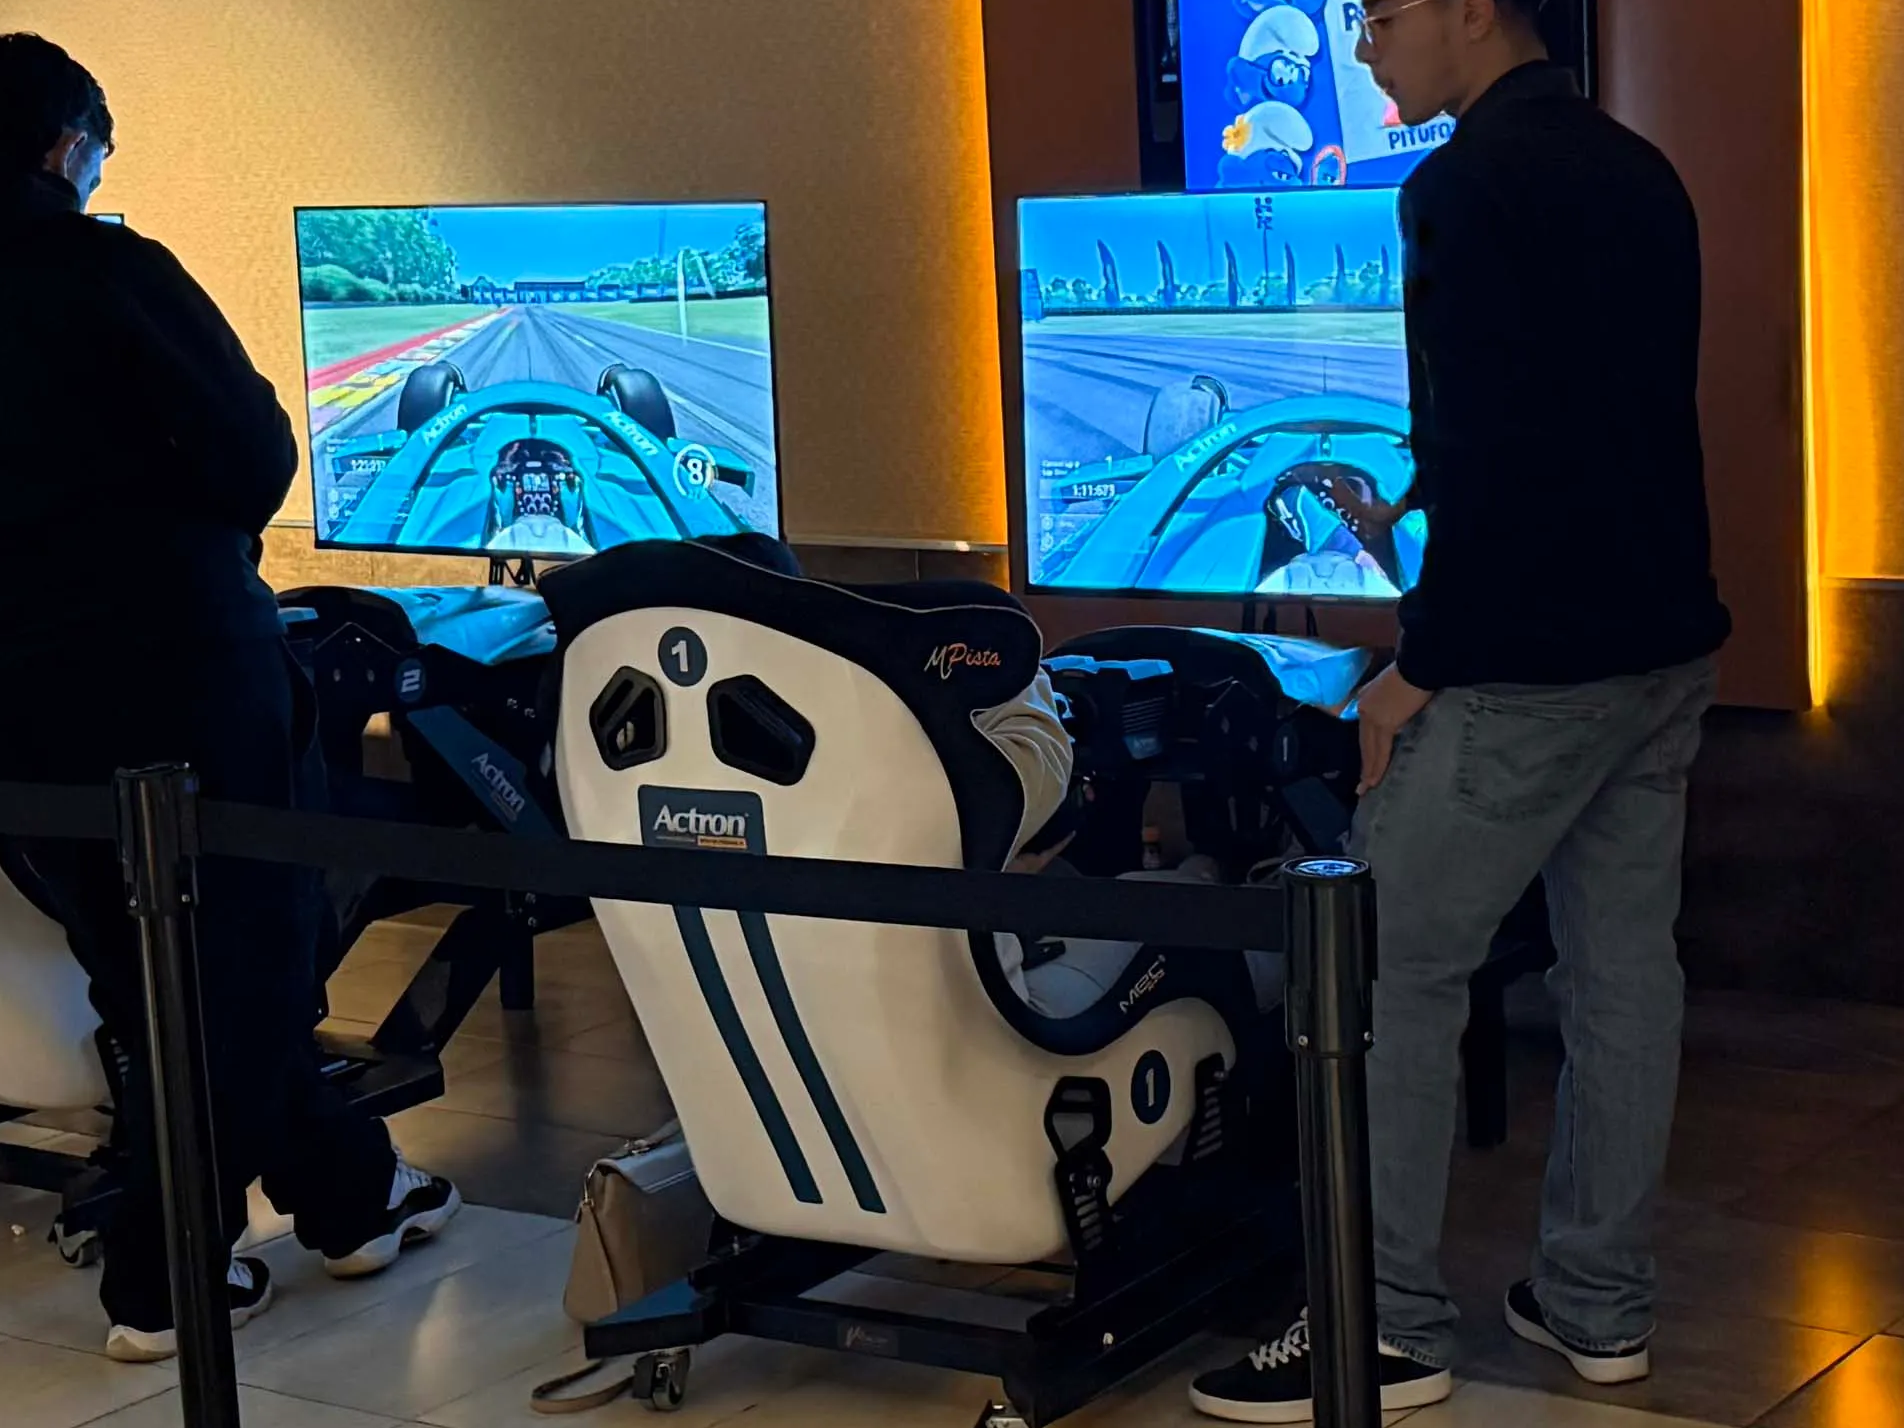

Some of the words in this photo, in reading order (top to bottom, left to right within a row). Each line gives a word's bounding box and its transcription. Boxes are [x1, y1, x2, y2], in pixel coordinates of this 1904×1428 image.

[1389, 122, 1453, 150] PITUFO
[687, 458, 704, 485] 8
[671, 640, 689, 672] 1
[400, 669, 421, 693] 2
[471, 752, 525, 813] Actron
[653, 804, 746, 837] Actron
[1146, 1067, 1155, 1107] 1
